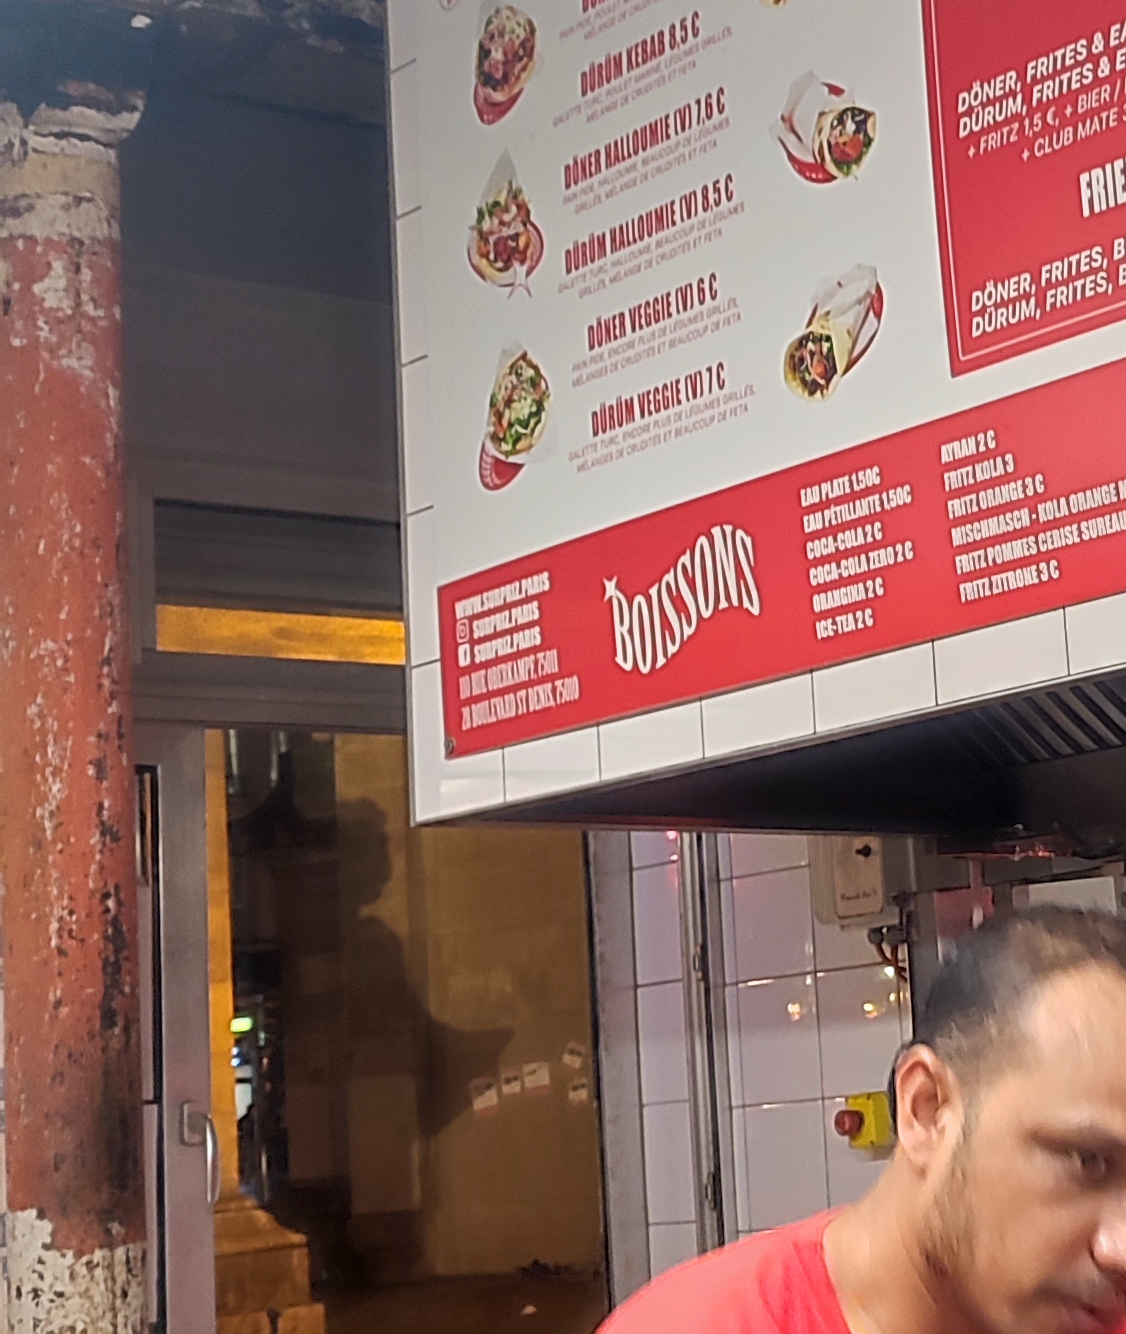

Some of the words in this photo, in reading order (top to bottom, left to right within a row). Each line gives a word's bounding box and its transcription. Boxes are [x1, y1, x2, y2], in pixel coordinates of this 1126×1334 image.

[580, 52, 622, 96] DÜRÜM
[626, 30, 665, 72] KEBAB
[668, 17, 688, 50] 8,5
[957, 71, 1021, 113] DÖNER,
[1026, 39, 1087, 83] FRITES
[1091, 32, 1104, 53] &
[564, 148, 601, 190] DÖNER
[604, 113, 671, 169] HALLOUMIE
[673, 103, 692, 136] (V)
[694, 92, 713, 126] 7,6
[564, 231, 607, 275] DÜRÜM
[609, 199, 677, 254] HALLOUMIE
[679, 189, 698, 223] (V)
[701, 178, 722, 213] 8,5
[587, 311, 626, 351] DÖNER
[628, 291, 672, 333] VEGGIE
[675, 282, 694, 314] (V)
[696, 277, 706, 306] 6
[971, 272, 1035, 312] DÖNER,
[1041, 246, 1107, 286] FRITES,
[971, 288, 1040, 337] DÜRUM,
[1046, 271, 1112, 311] FRITES,
[591, 396, 635, 437] DÜRÜM
[637, 378, 682, 419] VEGGIE
[684, 370, 704, 402] (V)
[705, 365, 713, 394] 7
[612, 524, 760, 675] BOISSONS
